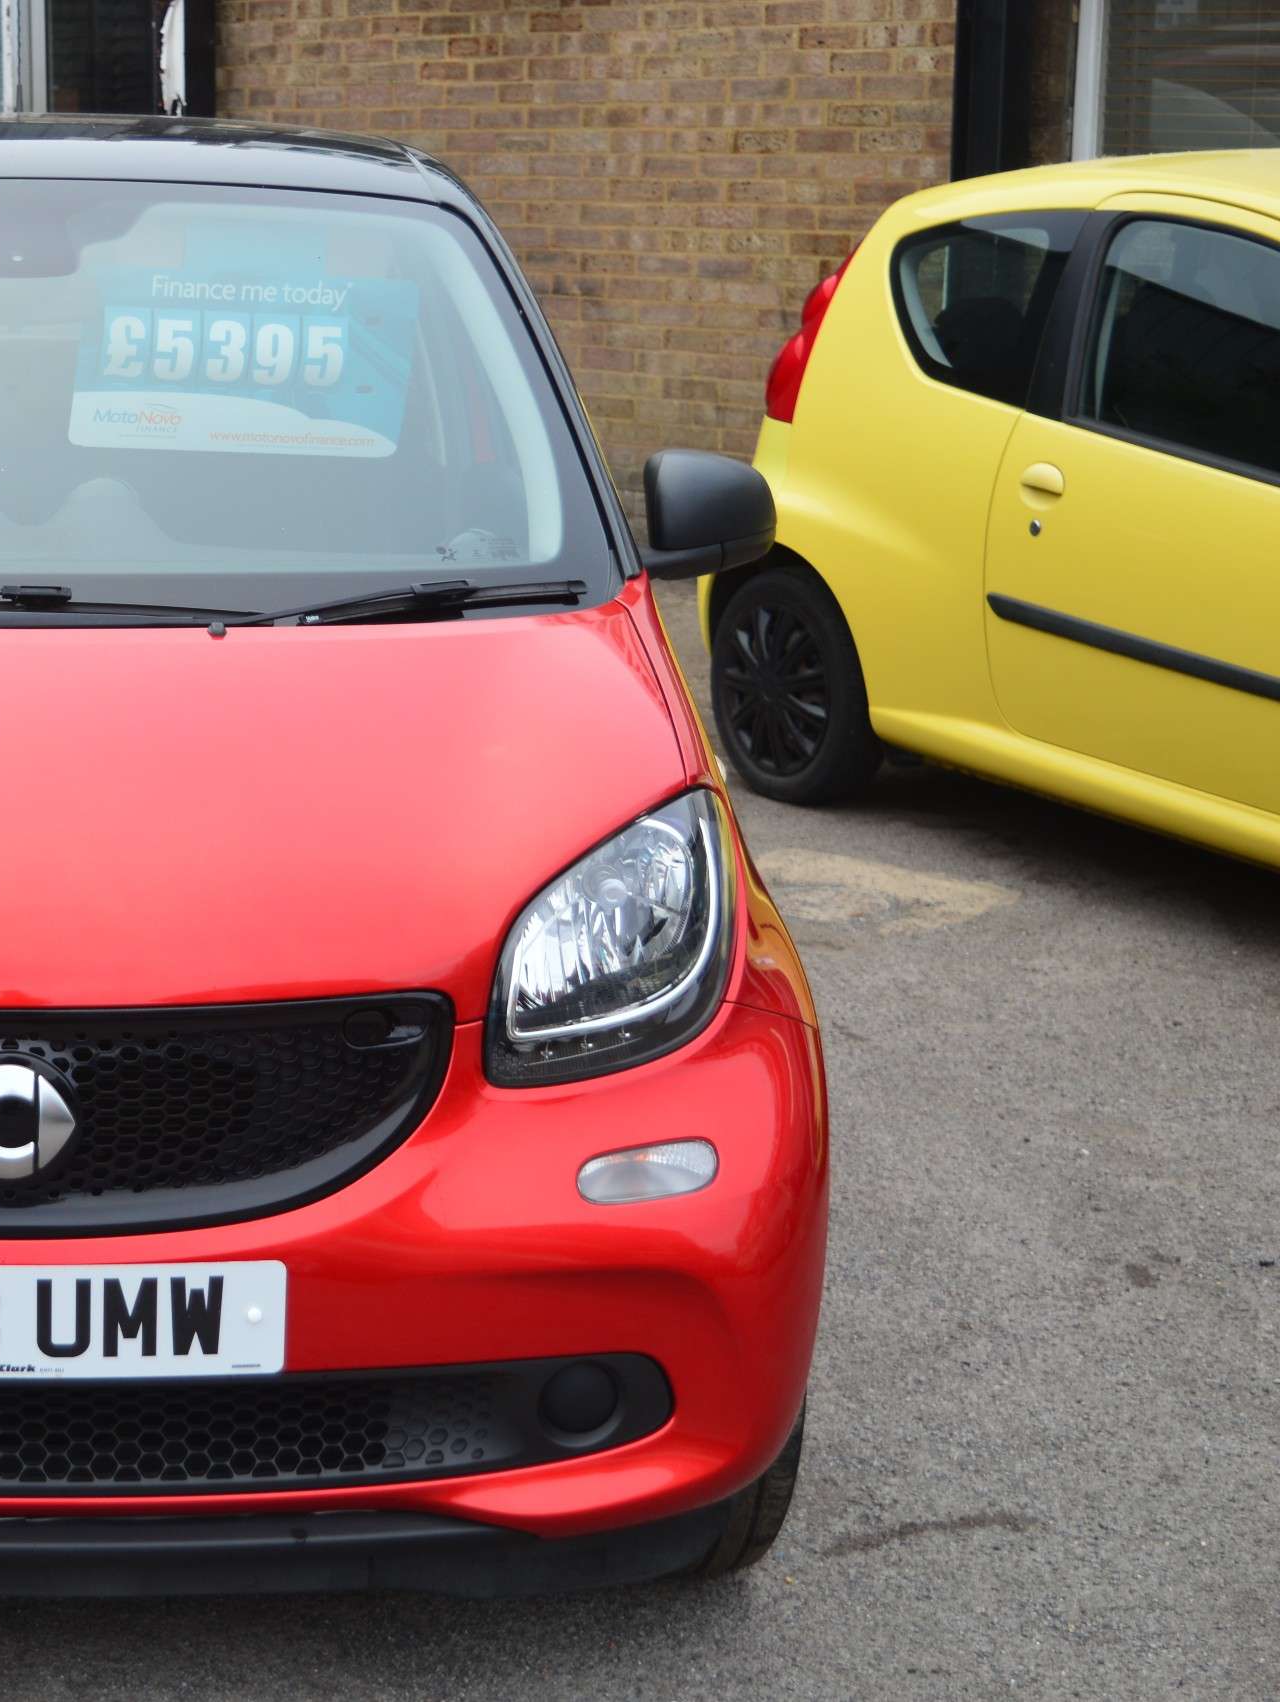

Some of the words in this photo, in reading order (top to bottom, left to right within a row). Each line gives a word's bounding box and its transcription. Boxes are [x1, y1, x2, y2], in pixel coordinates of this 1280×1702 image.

[151, 275, 236, 301] Finance
[241, 284, 278, 302] me
[104, 315, 345, 387] £5395
[36, 1275, 225, 1358] UMW
[0, 1363, 36, 1373] Clark
